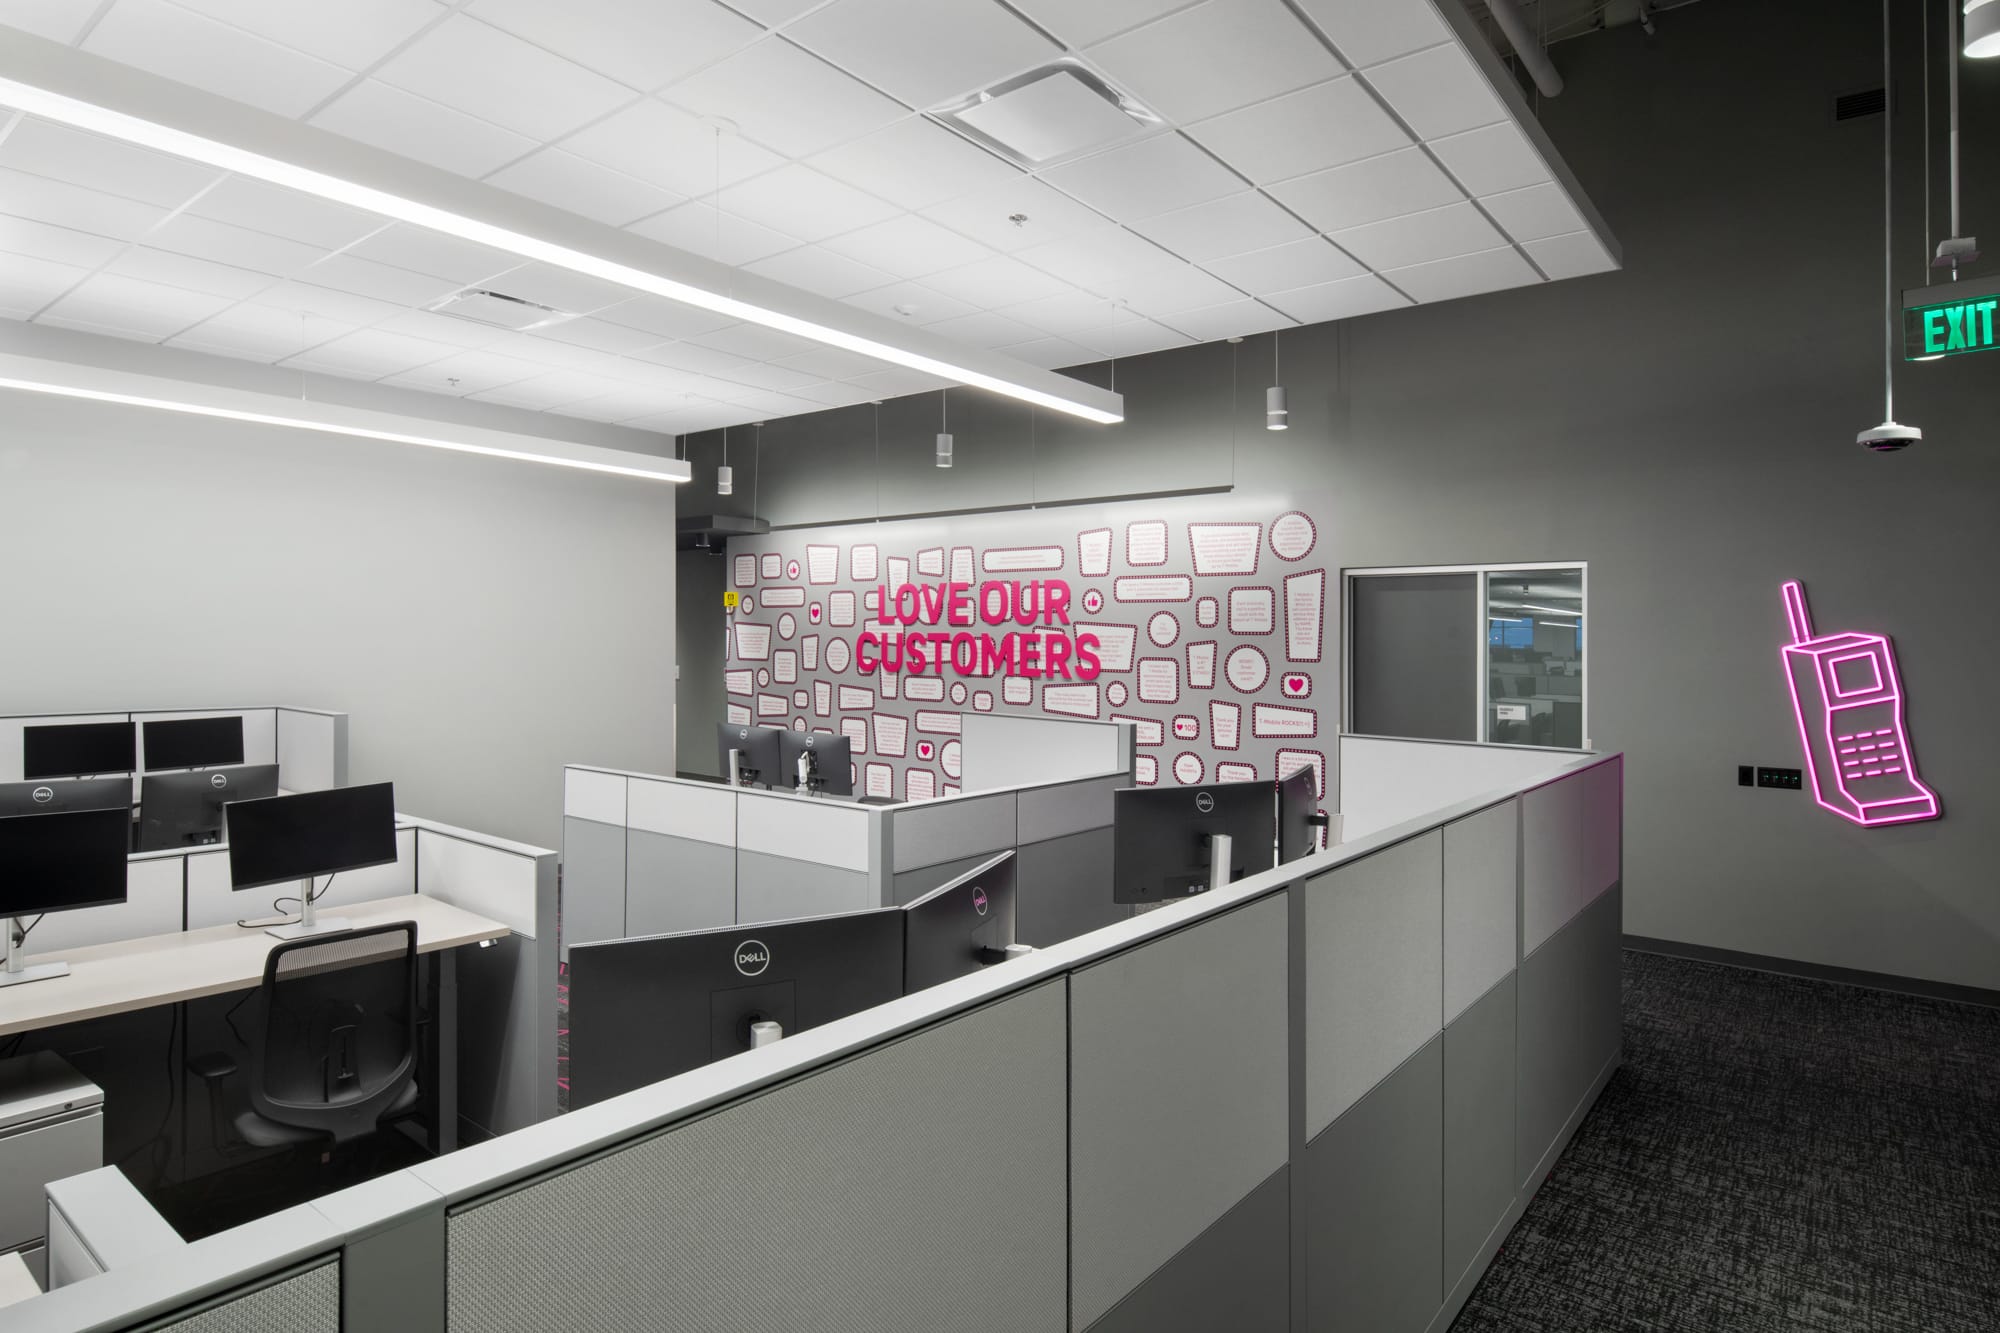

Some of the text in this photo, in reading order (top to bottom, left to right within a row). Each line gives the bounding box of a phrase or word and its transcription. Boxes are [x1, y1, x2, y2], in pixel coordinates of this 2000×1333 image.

[1923, 300, 1998, 353] EXIT
[877, 583, 969, 627] LOVE
[979, 580, 1071, 626] OUR
[855, 631, 1102, 681] CUSTOMERS
[738, 951, 767, 964] DELL
